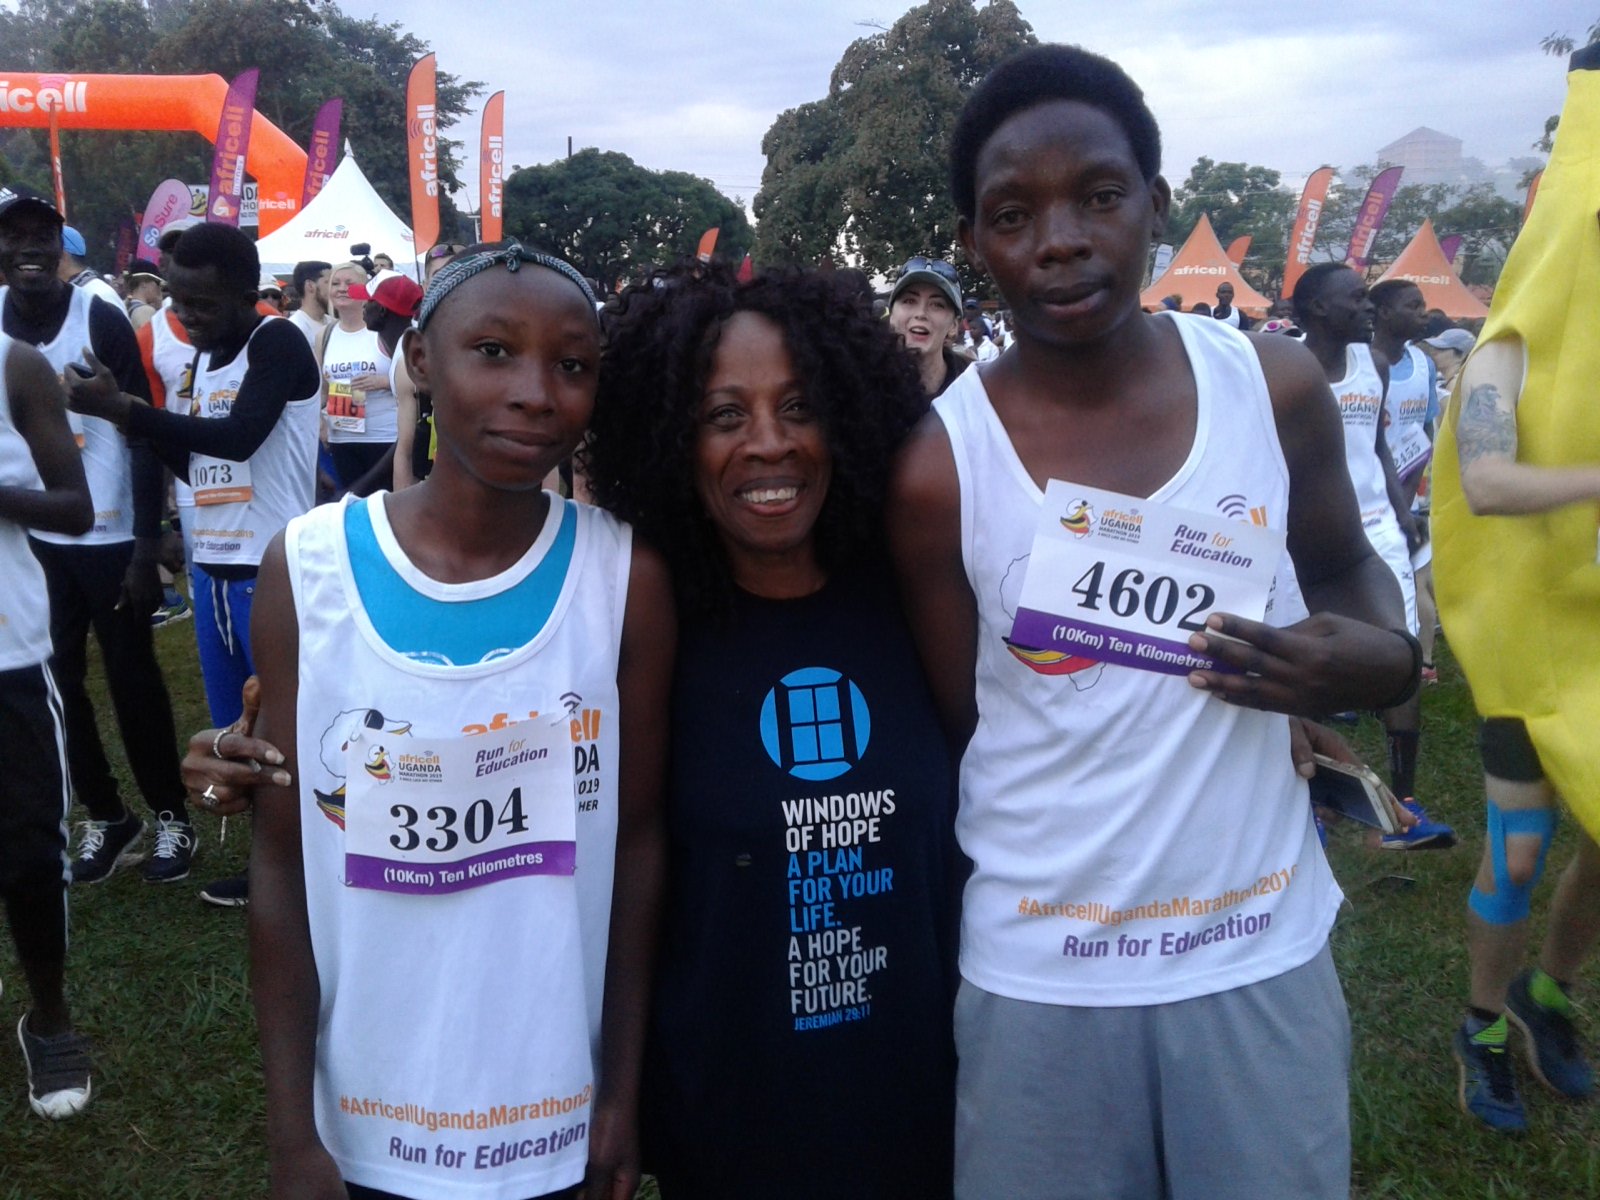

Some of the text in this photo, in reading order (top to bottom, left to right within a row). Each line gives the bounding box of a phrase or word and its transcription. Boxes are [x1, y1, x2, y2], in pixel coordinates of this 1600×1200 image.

[217, 106, 244, 194] africell
[418, 104, 438, 197] africell
[488, 136, 502, 217] africell
[144, 194, 177, 247] So Sure
[304, 228, 349, 239] africell
[1297, 199, 1322, 265] africell
[1351, 191, 1384, 258] africell
[1174, 265, 1226, 276] africell
[194, 463, 232, 487] 1073
[1100, 516, 1141, 534] UGANDA
[1103, 508, 1143, 525] africell
[1170, 539, 1253, 569] Education
[1174, 523, 1234, 549] Run for
[1071, 560, 1215, 632] 4602
[1052, 624, 1214, 670] (10Km) Ten Kilometres
[398, 762, 442, 773] UGANDA
[399, 754, 440, 764] africell
[475, 738, 526, 764] Run for
[475, 747, 548, 778] Education
[389, 786, 530, 853] 3304
[782, 789, 897, 826] WINDOWS
[786, 817, 881, 853] OF HOPE
[383, 852, 544, 888] (10Km) Ten Kilometres
[787, 846, 863, 879] A PLAN
[788, 867, 894, 906] FOR YOUR
[790, 902, 843, 934] LIFE.
[1063, 911, 1272, 957] Run for Education
[787, 925, 863, 962] A HOPE
[789, 946, 888, 989] FOR YOUR
[791, 978, 873, 1014] FUTURE.
[390, 1122, 587, 1170] Run for Education
